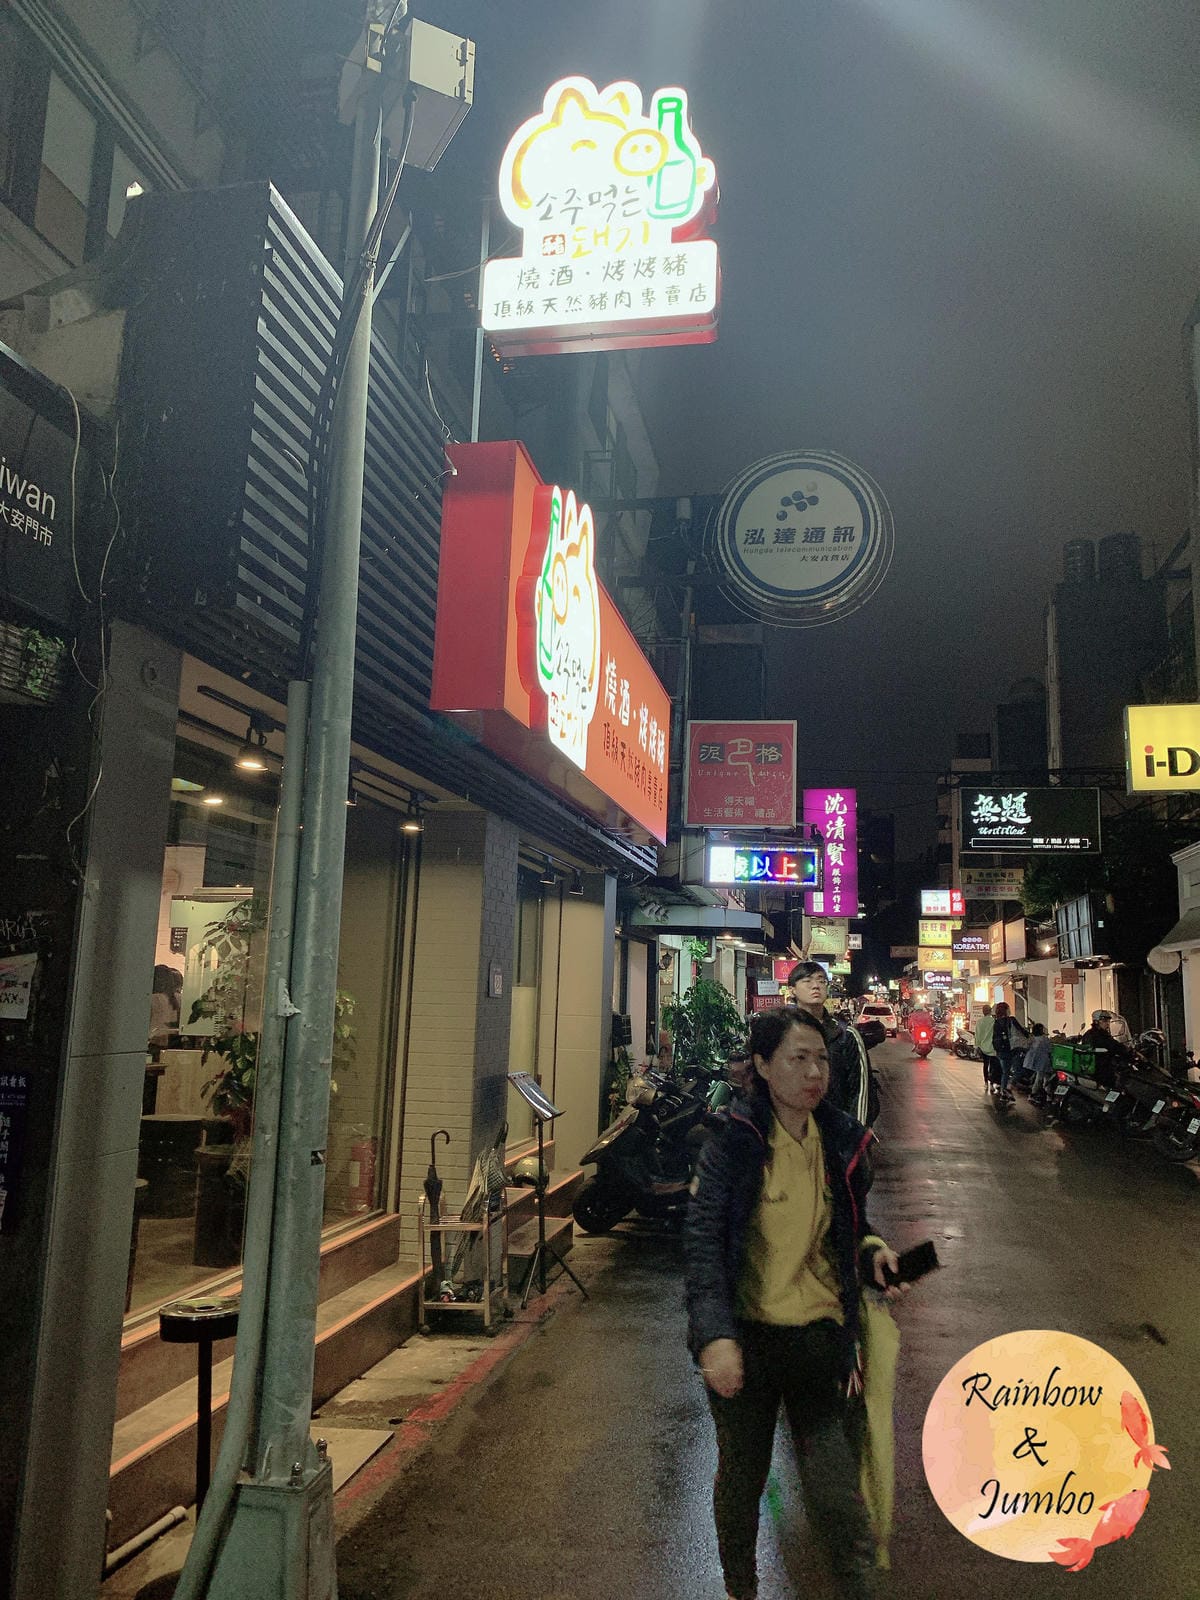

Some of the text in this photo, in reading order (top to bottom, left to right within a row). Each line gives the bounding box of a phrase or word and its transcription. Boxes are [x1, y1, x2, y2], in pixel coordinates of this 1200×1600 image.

[493, 283, 707, 318] 頂級天然豬肉專賣店
[743, 526, 855, 545] 泓達通訊
[825, 792, 847, 866] 沈清賢
